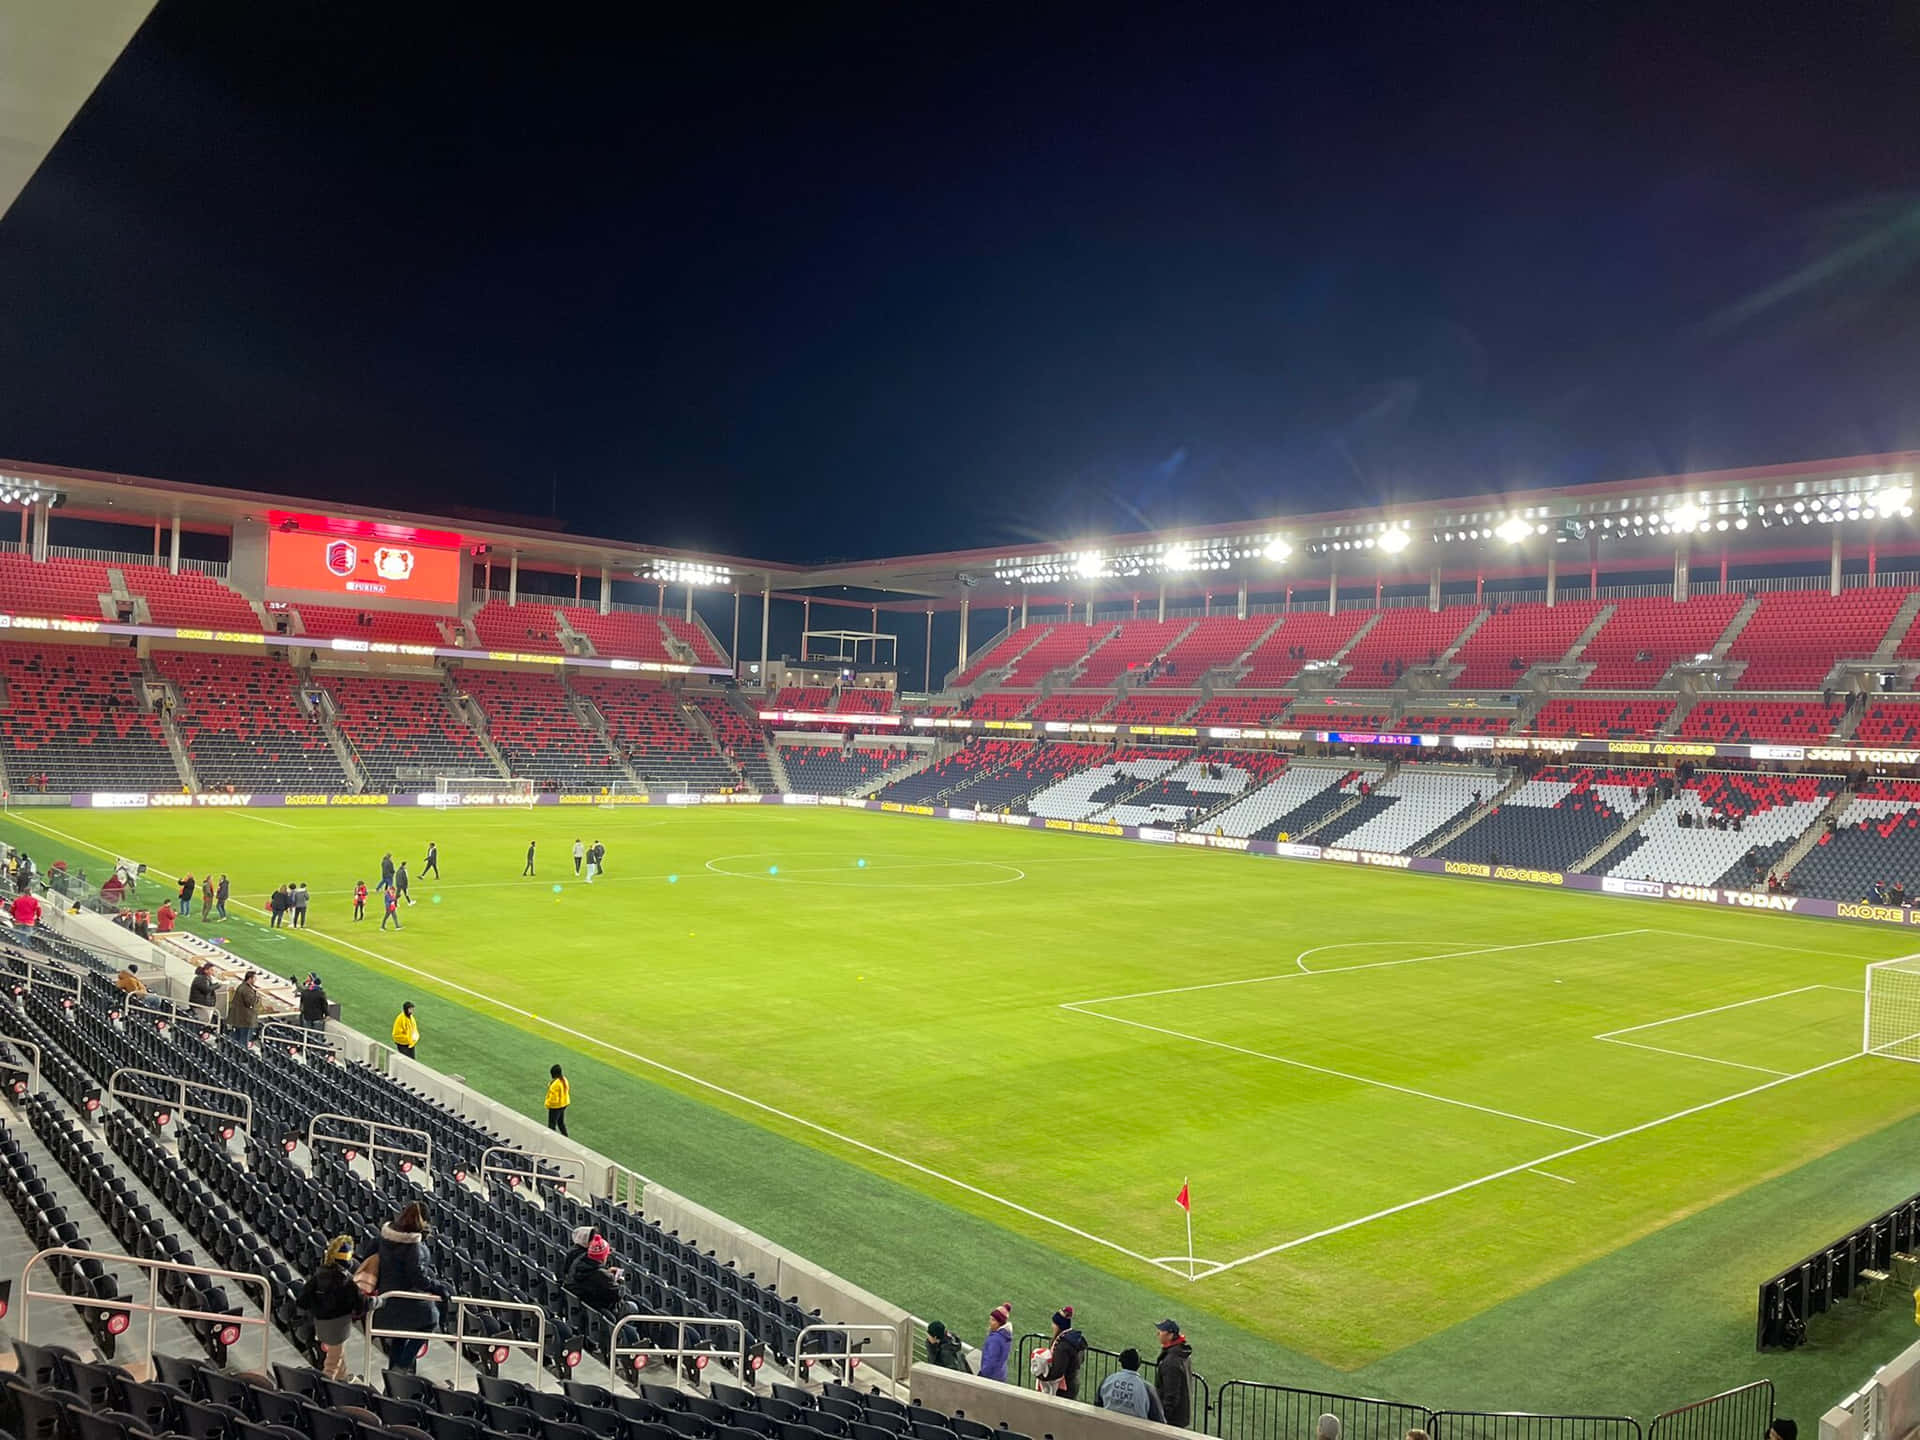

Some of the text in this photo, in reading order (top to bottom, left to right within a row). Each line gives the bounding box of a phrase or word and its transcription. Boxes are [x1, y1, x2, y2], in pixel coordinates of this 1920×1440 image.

[12, 616, 48, 630] JOIN
[1496, 738, 1528, 748] JOIN
[1530, 740, 1578, 751] TODAY
[1608, 742, 1716, 756] MORE ACCESS
[1808, 749, 1850, 761] JOIN
[1856, 751, 1920, 764] TODAY
[150, 794, 192, 806] JOIN
[196, 794, 251, 806] TODAY
[462, 794, 494, 805] JOIN
[497, 794, 540, 804] TODAY
[1176, 833, 1206, 846] JOIN
[1208, 835, 1250, 850] TODAY
[1322, 848, 1358, 862] JOIN
[1360, 852, 1412, 868] TODAY
[1445, 861, 1564, 885] MORE ACCESS
[1668, 885, 1718, 902] JOIN
[1724, 889, 1799, 911] TODAY
[1838, 903, 1904, 922] MORE
